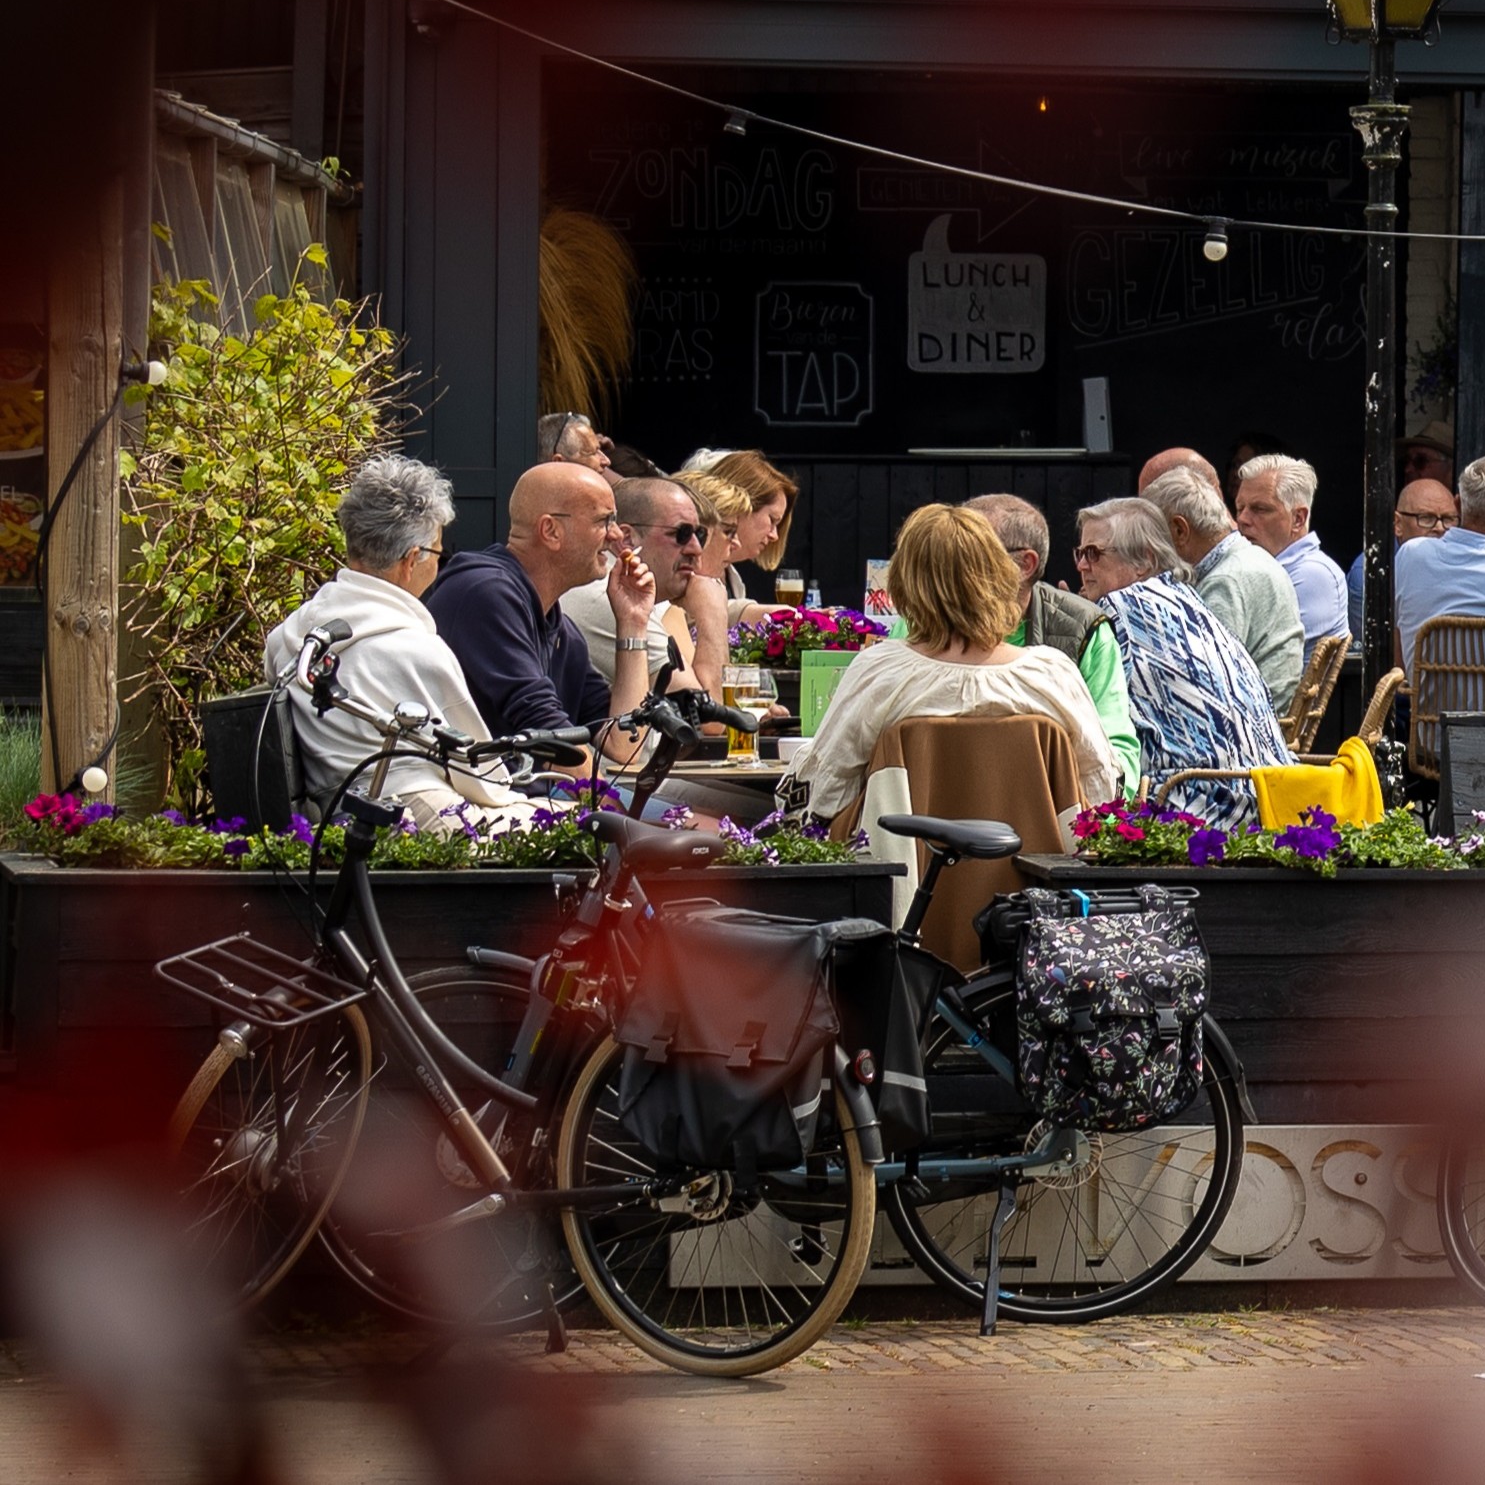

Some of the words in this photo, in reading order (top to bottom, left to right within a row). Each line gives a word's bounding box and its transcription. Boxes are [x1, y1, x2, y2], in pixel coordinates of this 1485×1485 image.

[588, 146, 837, 233] ZONDAG
[921, 260, 1031, 289] LUNCH
[1067, 229, 1327, 338] GEZELLIG
[966, 292, 986, 323] &
[636, 328, 715, 373] RAS
[917, 331, 1037, 364] DINER
[765, 350, 861, 417] TAP
